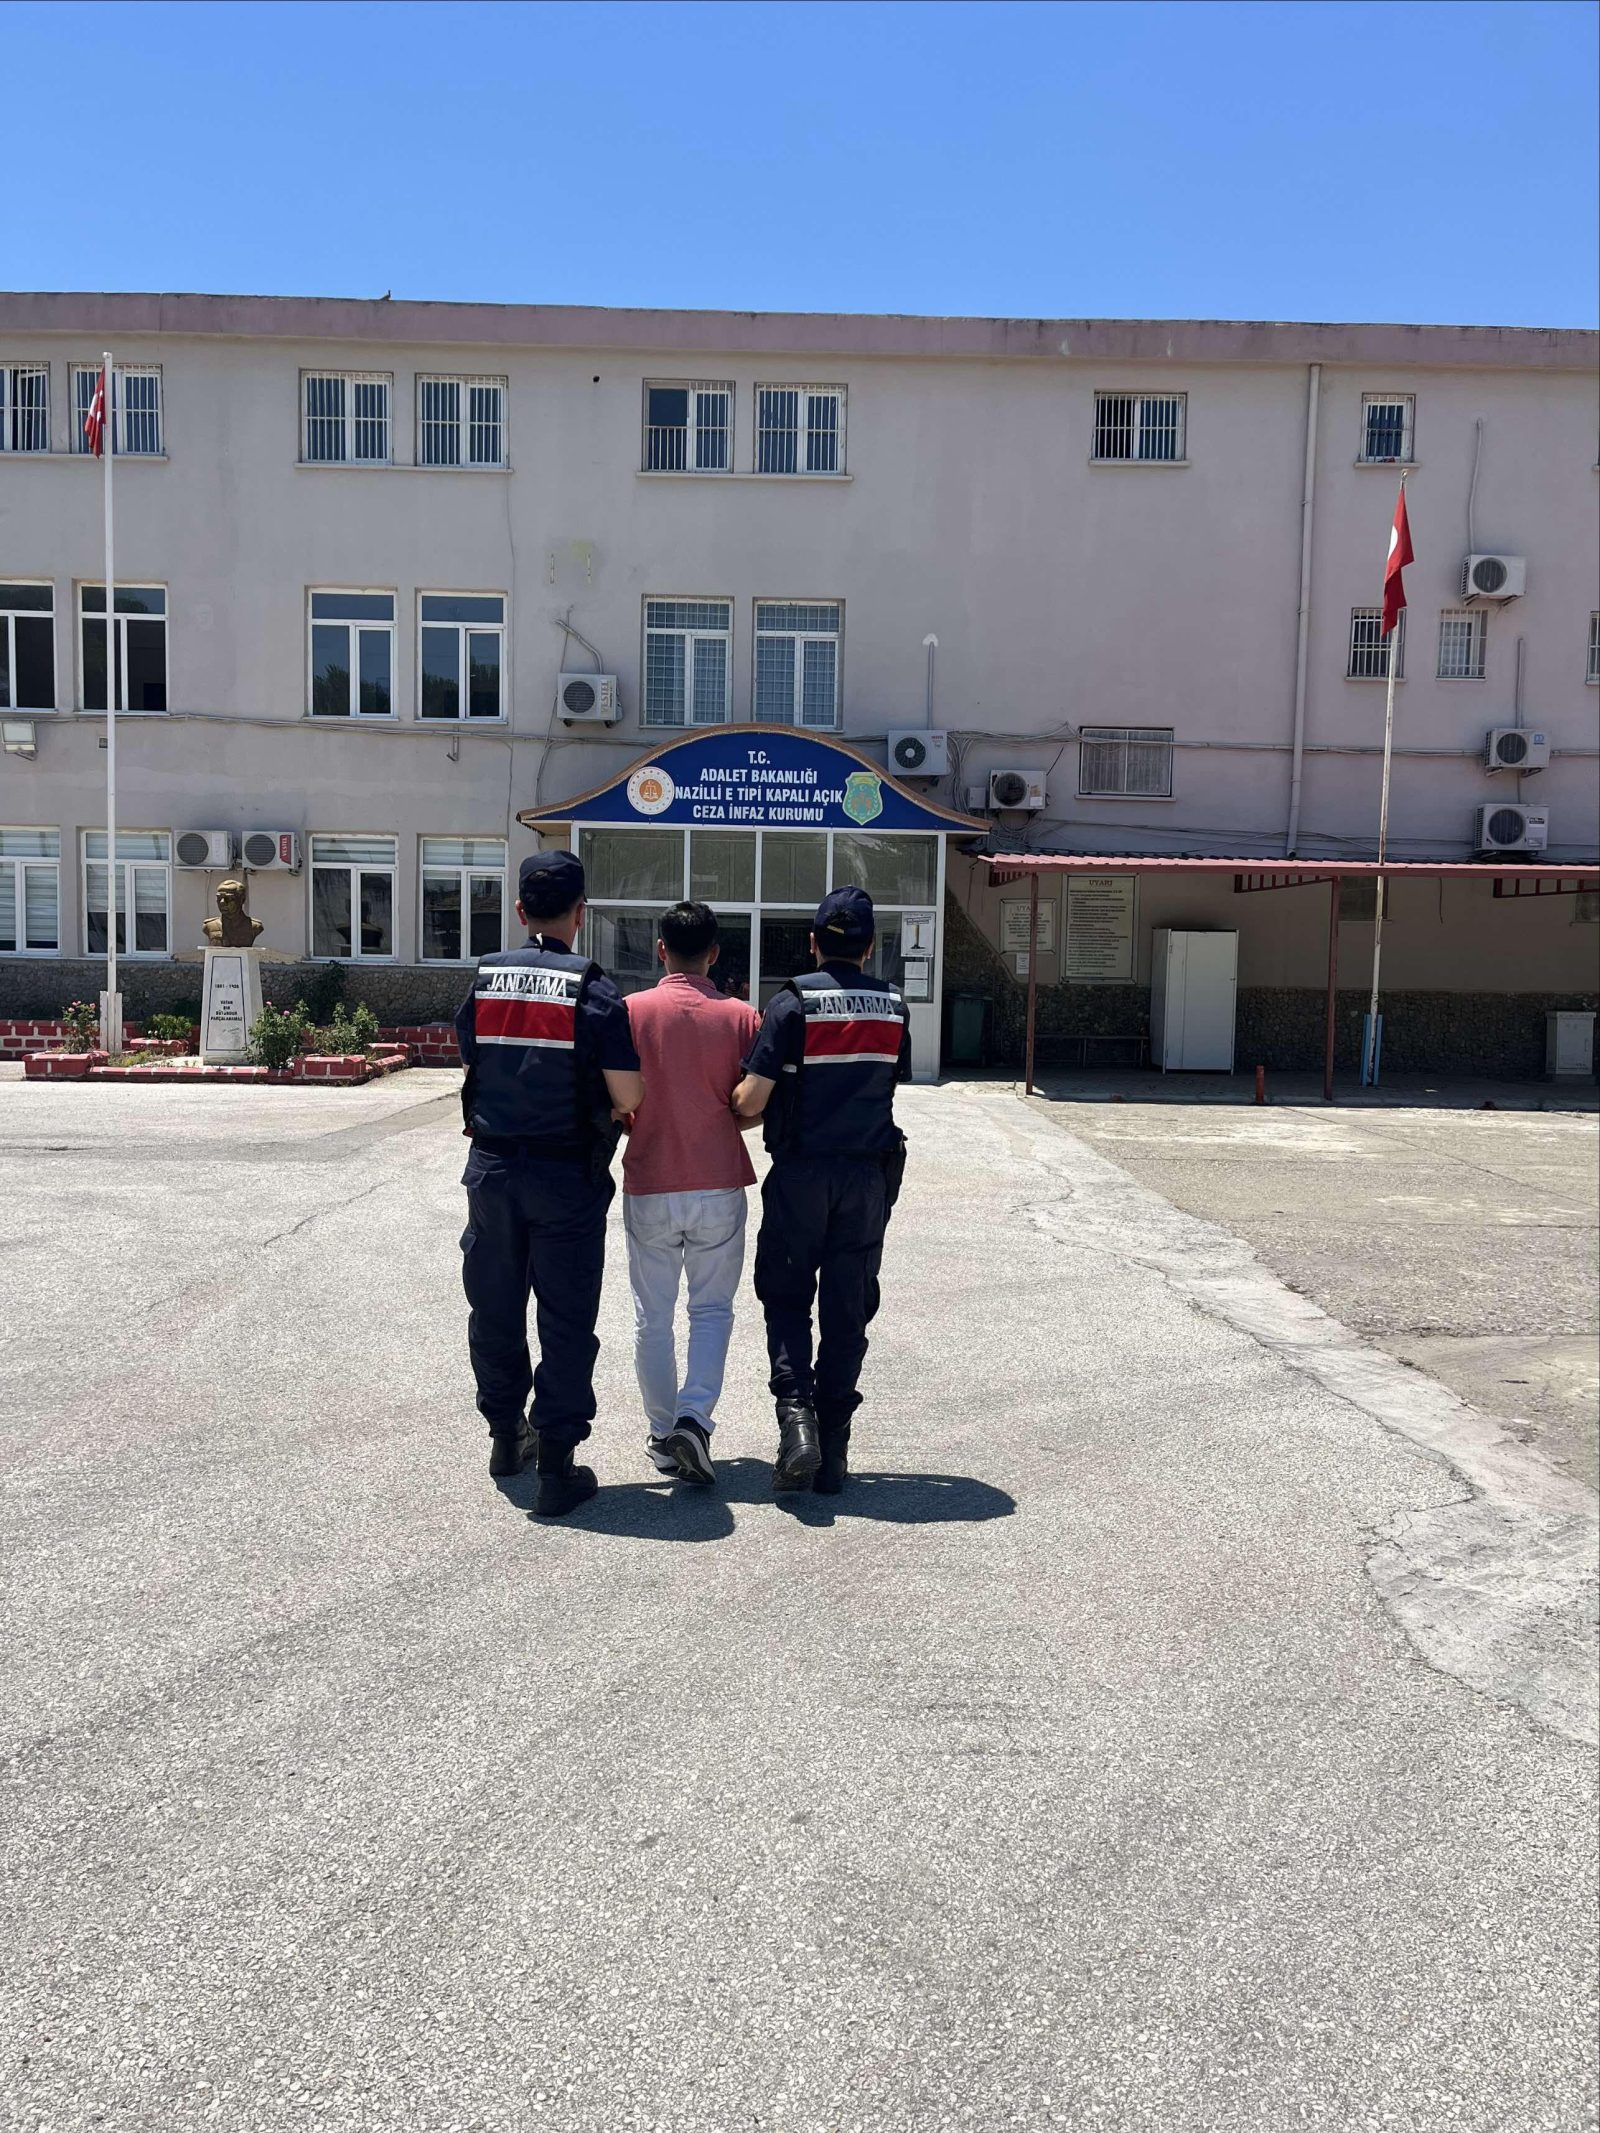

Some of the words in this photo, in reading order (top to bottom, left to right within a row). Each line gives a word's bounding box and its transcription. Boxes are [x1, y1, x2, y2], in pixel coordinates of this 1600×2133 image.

[748, 750, 771, 765] T.C.
[700, 768, 748, 783] ADALET
[751, 767, 818, 784] BAKANLIĞI
[674, 783, 722, 801] NAZİLLİ
[725, 787, 733, 801] E
[737, 785, 762, 802] TİPİ
[765, 788, 809, 803] KAPALI
[812, 789, 843, 806] AÇIK
[693, 804, 725, 819] CEZA
[729, 802, 764, 820] İNFAZ
[768, 807, 824, 822] KURUMU
[486, 973, 567, 997] JANDARMA
[816, 996, 895, 1015] JANDARMA
